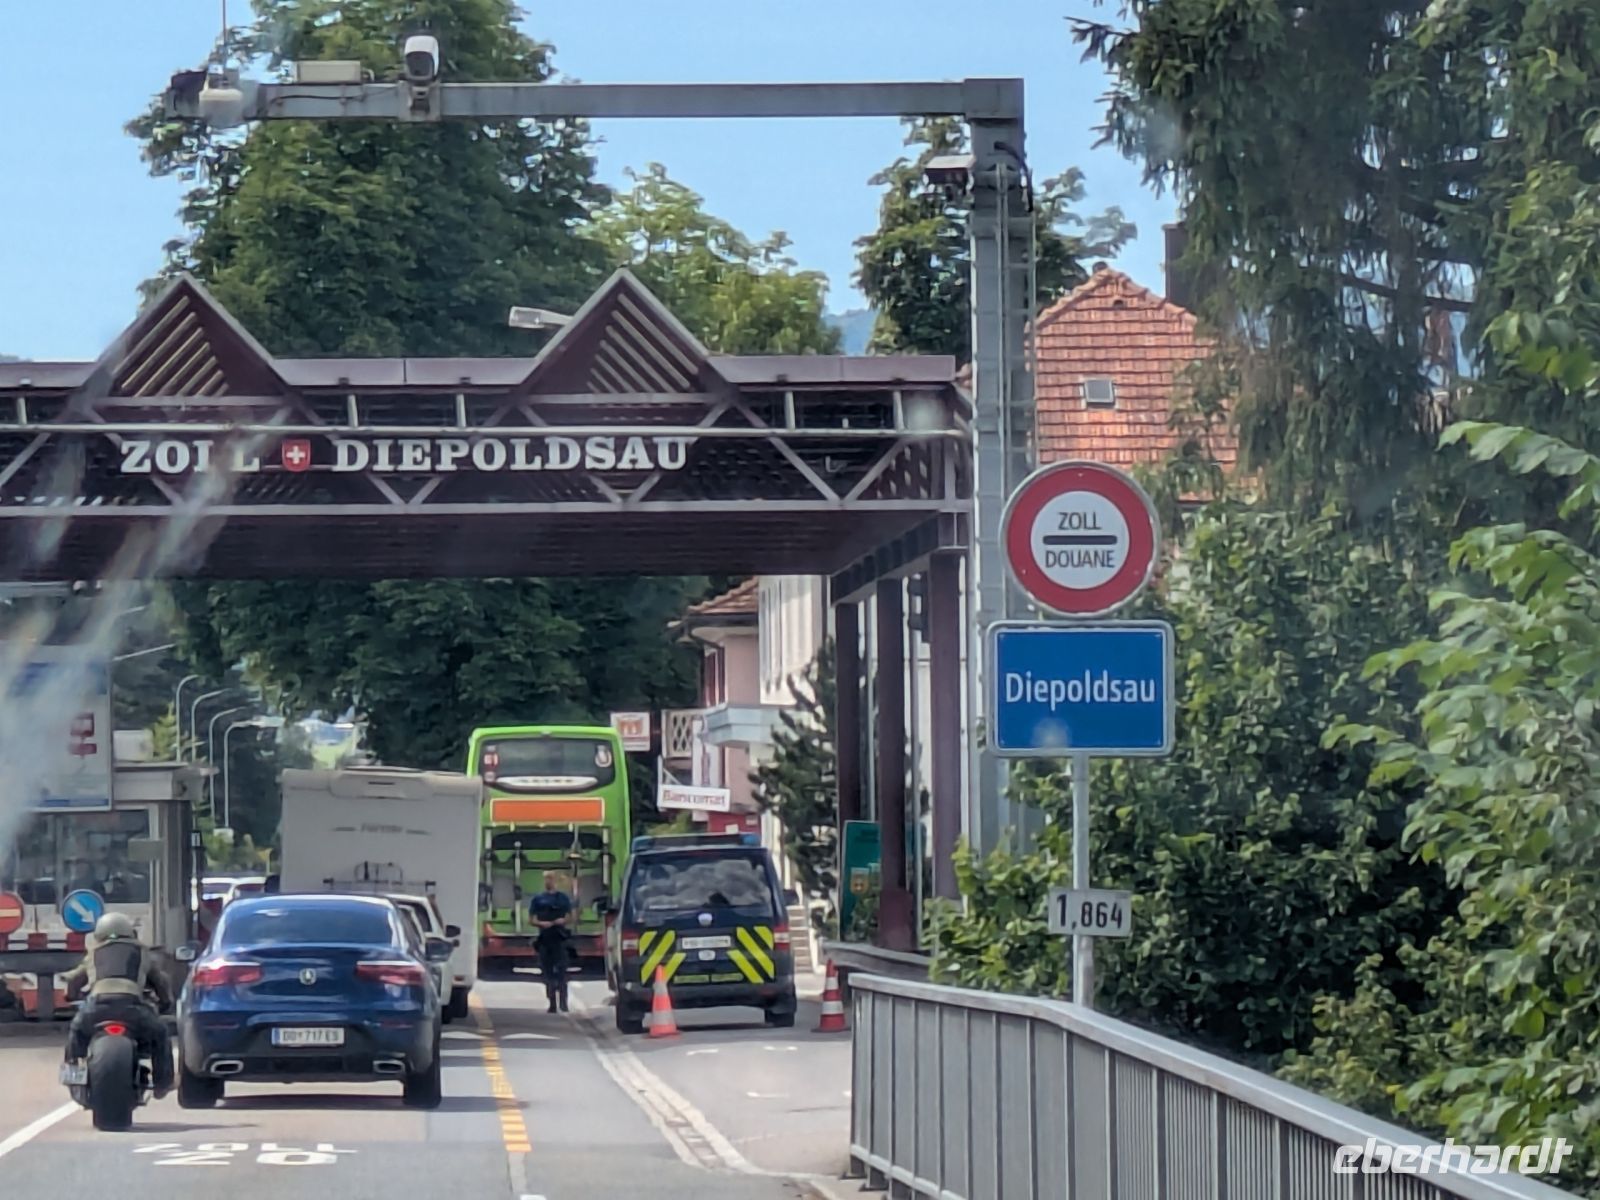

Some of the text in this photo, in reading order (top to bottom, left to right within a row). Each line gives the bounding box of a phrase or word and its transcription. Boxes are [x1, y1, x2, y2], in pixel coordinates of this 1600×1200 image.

[331, 437, 692, 472] DIEPOLDSAU
[1058, 512, 1102, 530] ZOLL
[1045, 550, 1115, 568] DOUANE
[1005, 669, 1155, 711] Diepoldsau
[1057, 893, 1122, 930] 1,864
